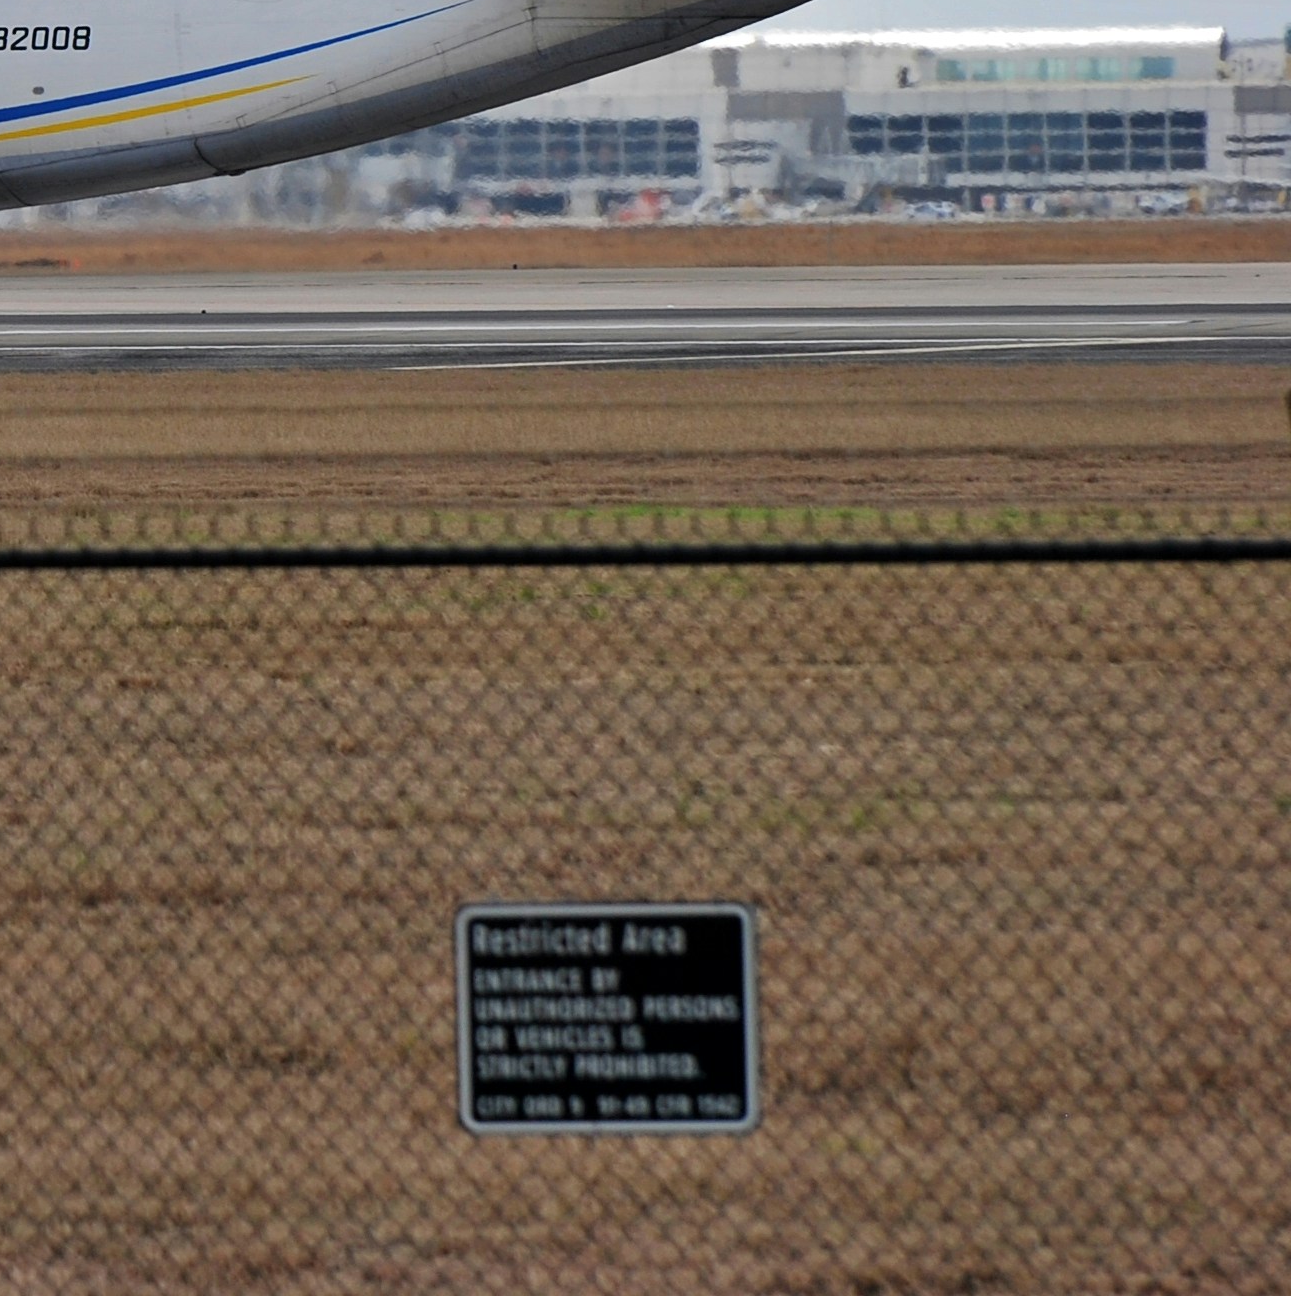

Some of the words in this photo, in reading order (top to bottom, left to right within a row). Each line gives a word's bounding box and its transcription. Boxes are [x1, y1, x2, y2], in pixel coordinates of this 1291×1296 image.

[473, 923, 611, 955] Restricted
[622, 923, 687, 954] Area
[473, 967, 582, 993] ENTRANCE
[474, 995, 636, 1022] UNAUTHORIZED
[642, 995, 740, 1022] PERSONS
[515, 1024, 615, 1050] VEHICLES
[477, 1054, 567, 1080] STRICTLY
